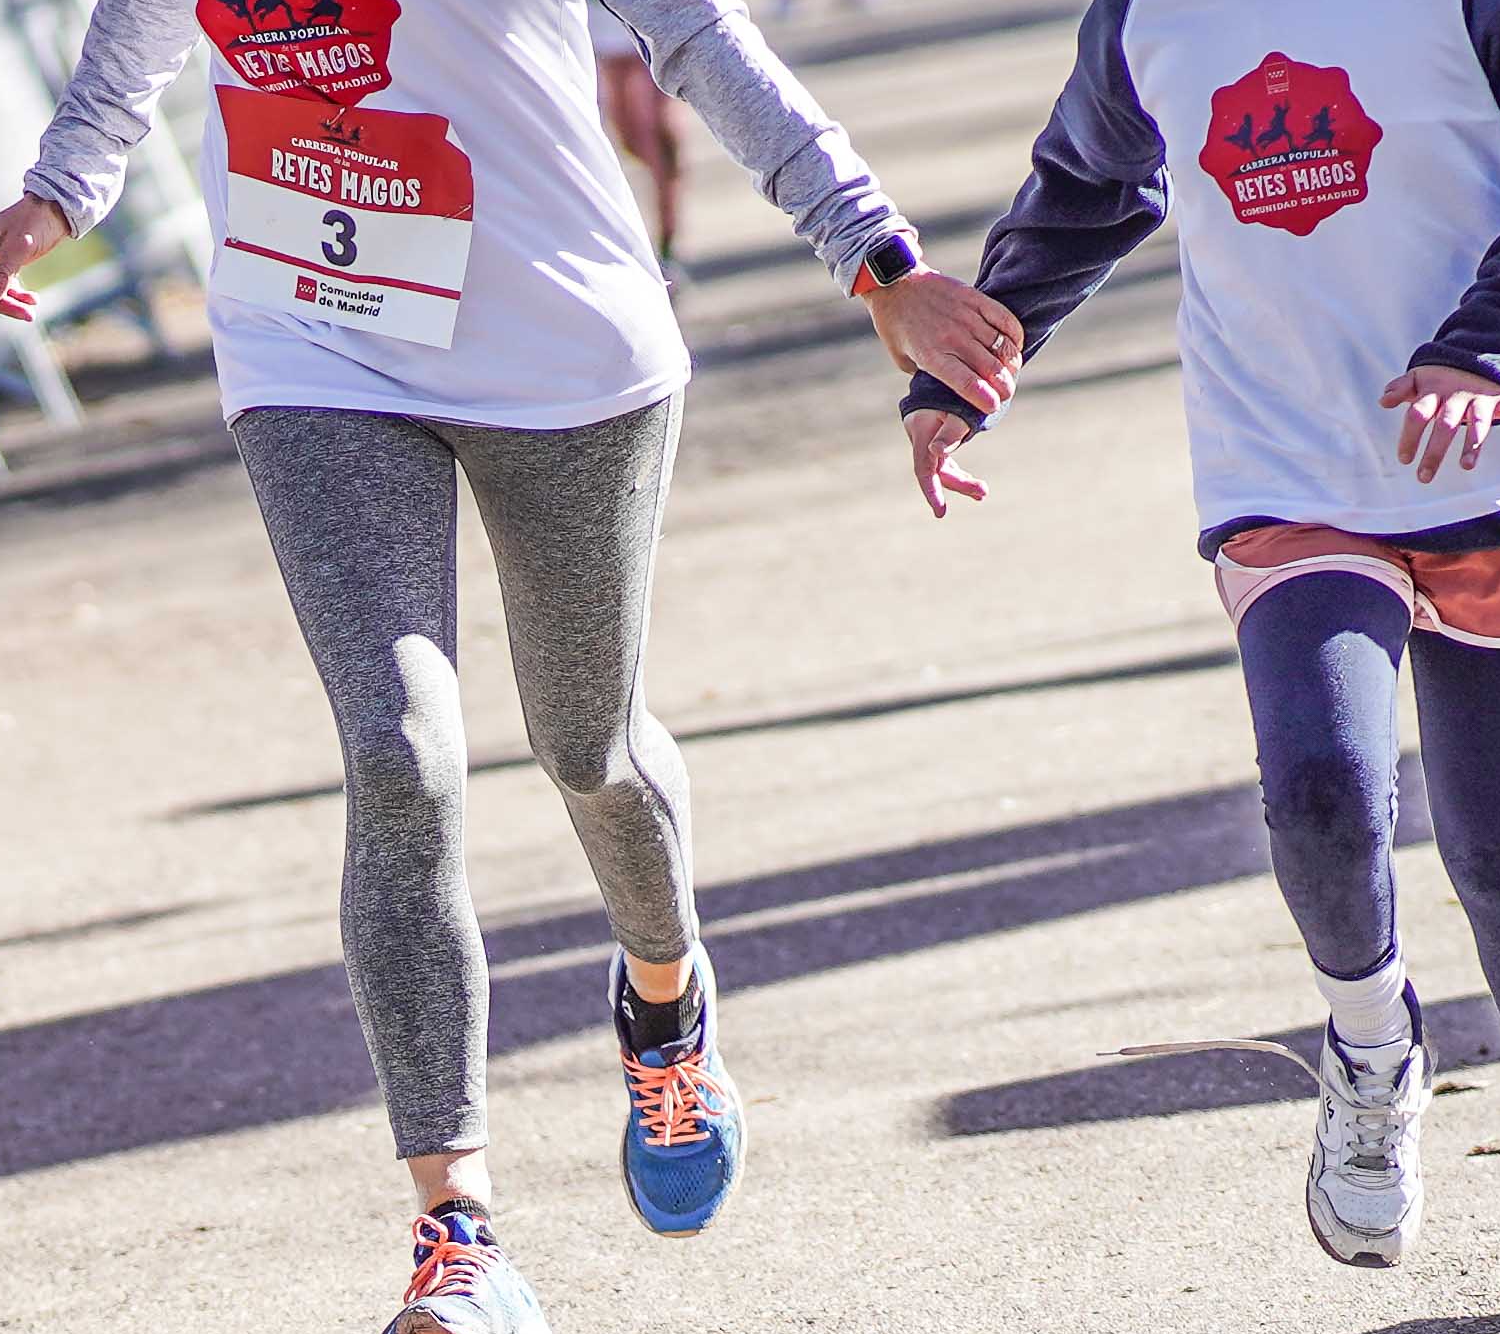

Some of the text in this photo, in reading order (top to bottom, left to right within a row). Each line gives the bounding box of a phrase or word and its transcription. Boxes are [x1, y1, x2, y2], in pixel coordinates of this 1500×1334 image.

[295, 42, 375, 79] MAGOS
[332, 72, 382, 92] MADRID
[291, 137, 400, 172] CARRERA POPULAR
[1239, 154, 1286, 172] CARRERA
[1288, 149, 1339, 162] POPULAR
[271, 147, 422, 208] REYES MAGOS
[1234, 160, 1356, 203] REYES MAGOS
[1241, 188, 1360, 217] COMUNIDAD DE MADRID
[320, 209, 358, 267] 3
[318, 296, 380, 317] de Madrid
[319, 282, 384, 303] Comunidad
